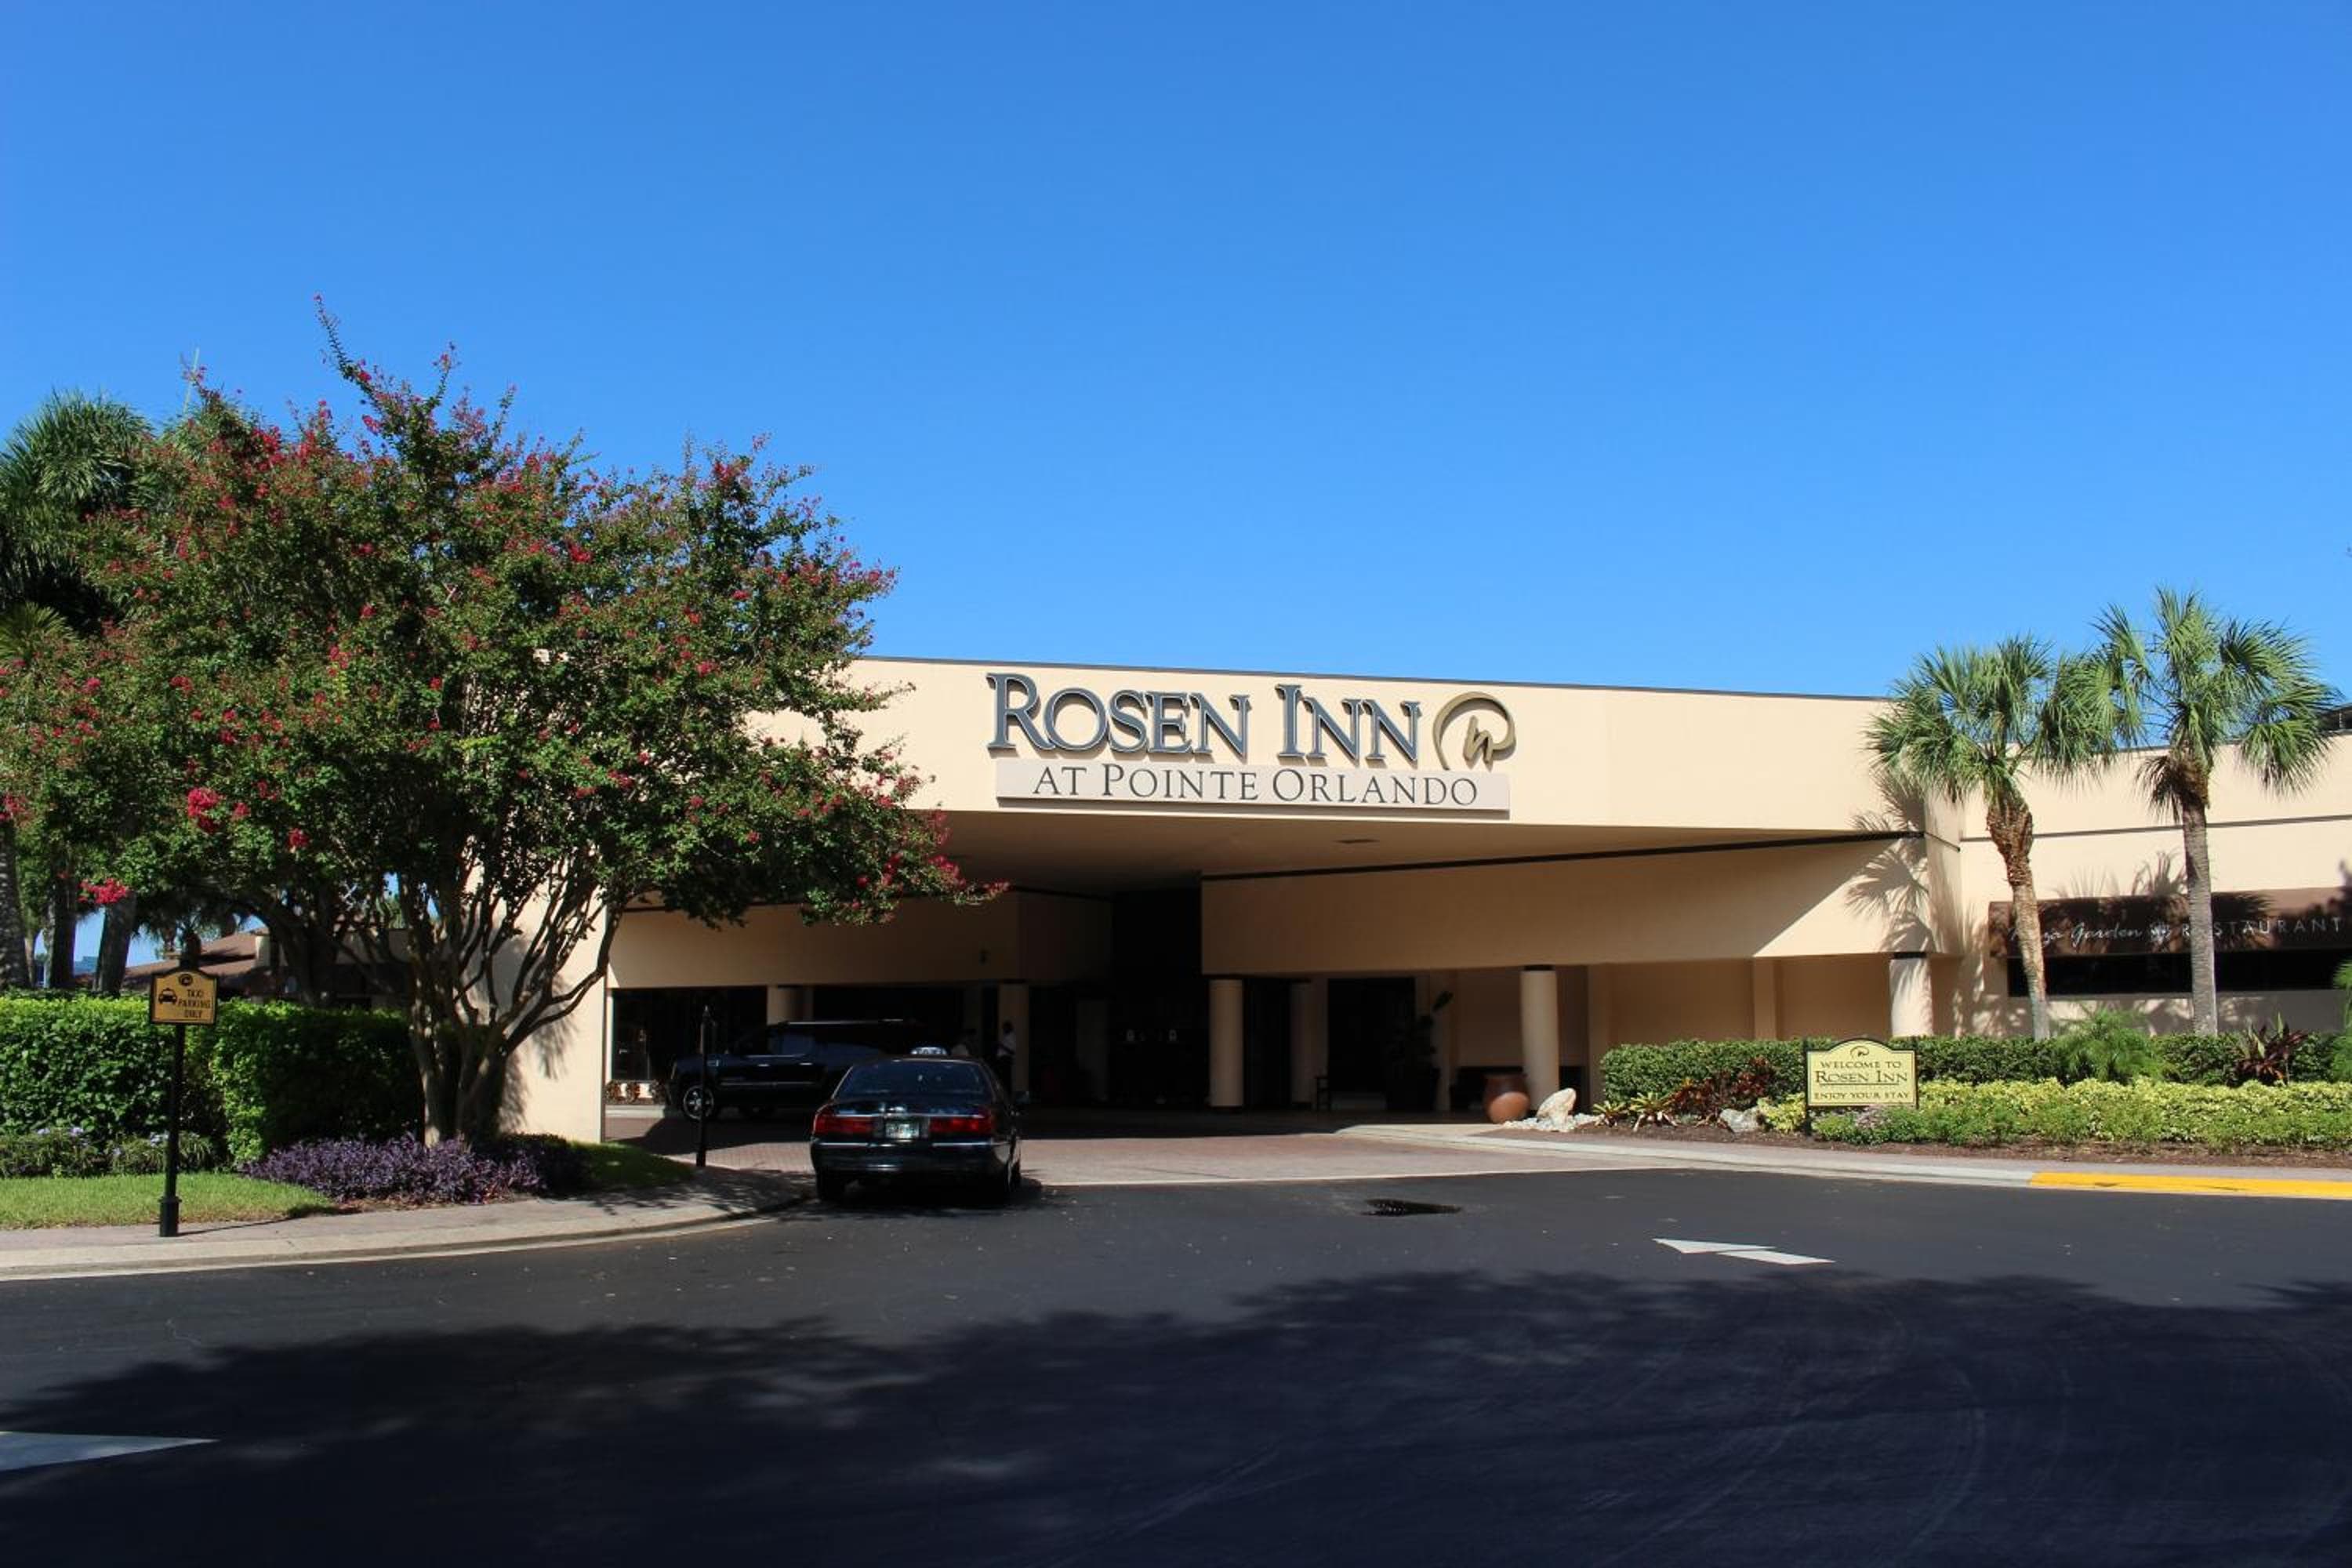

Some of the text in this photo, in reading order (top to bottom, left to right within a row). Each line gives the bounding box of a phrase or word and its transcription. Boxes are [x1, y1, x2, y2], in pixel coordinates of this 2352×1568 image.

[986, 672, 1421, 762] ROSEN INN
[1033, 763, 1478, 807] AT POINTE ORLANDO
[2182, 916, 2343, 937] RSTAURANT
[1815, 1071, 1907, 1083] ROSEN INN
[1849, 1091, 1881, 1100] YOUR
